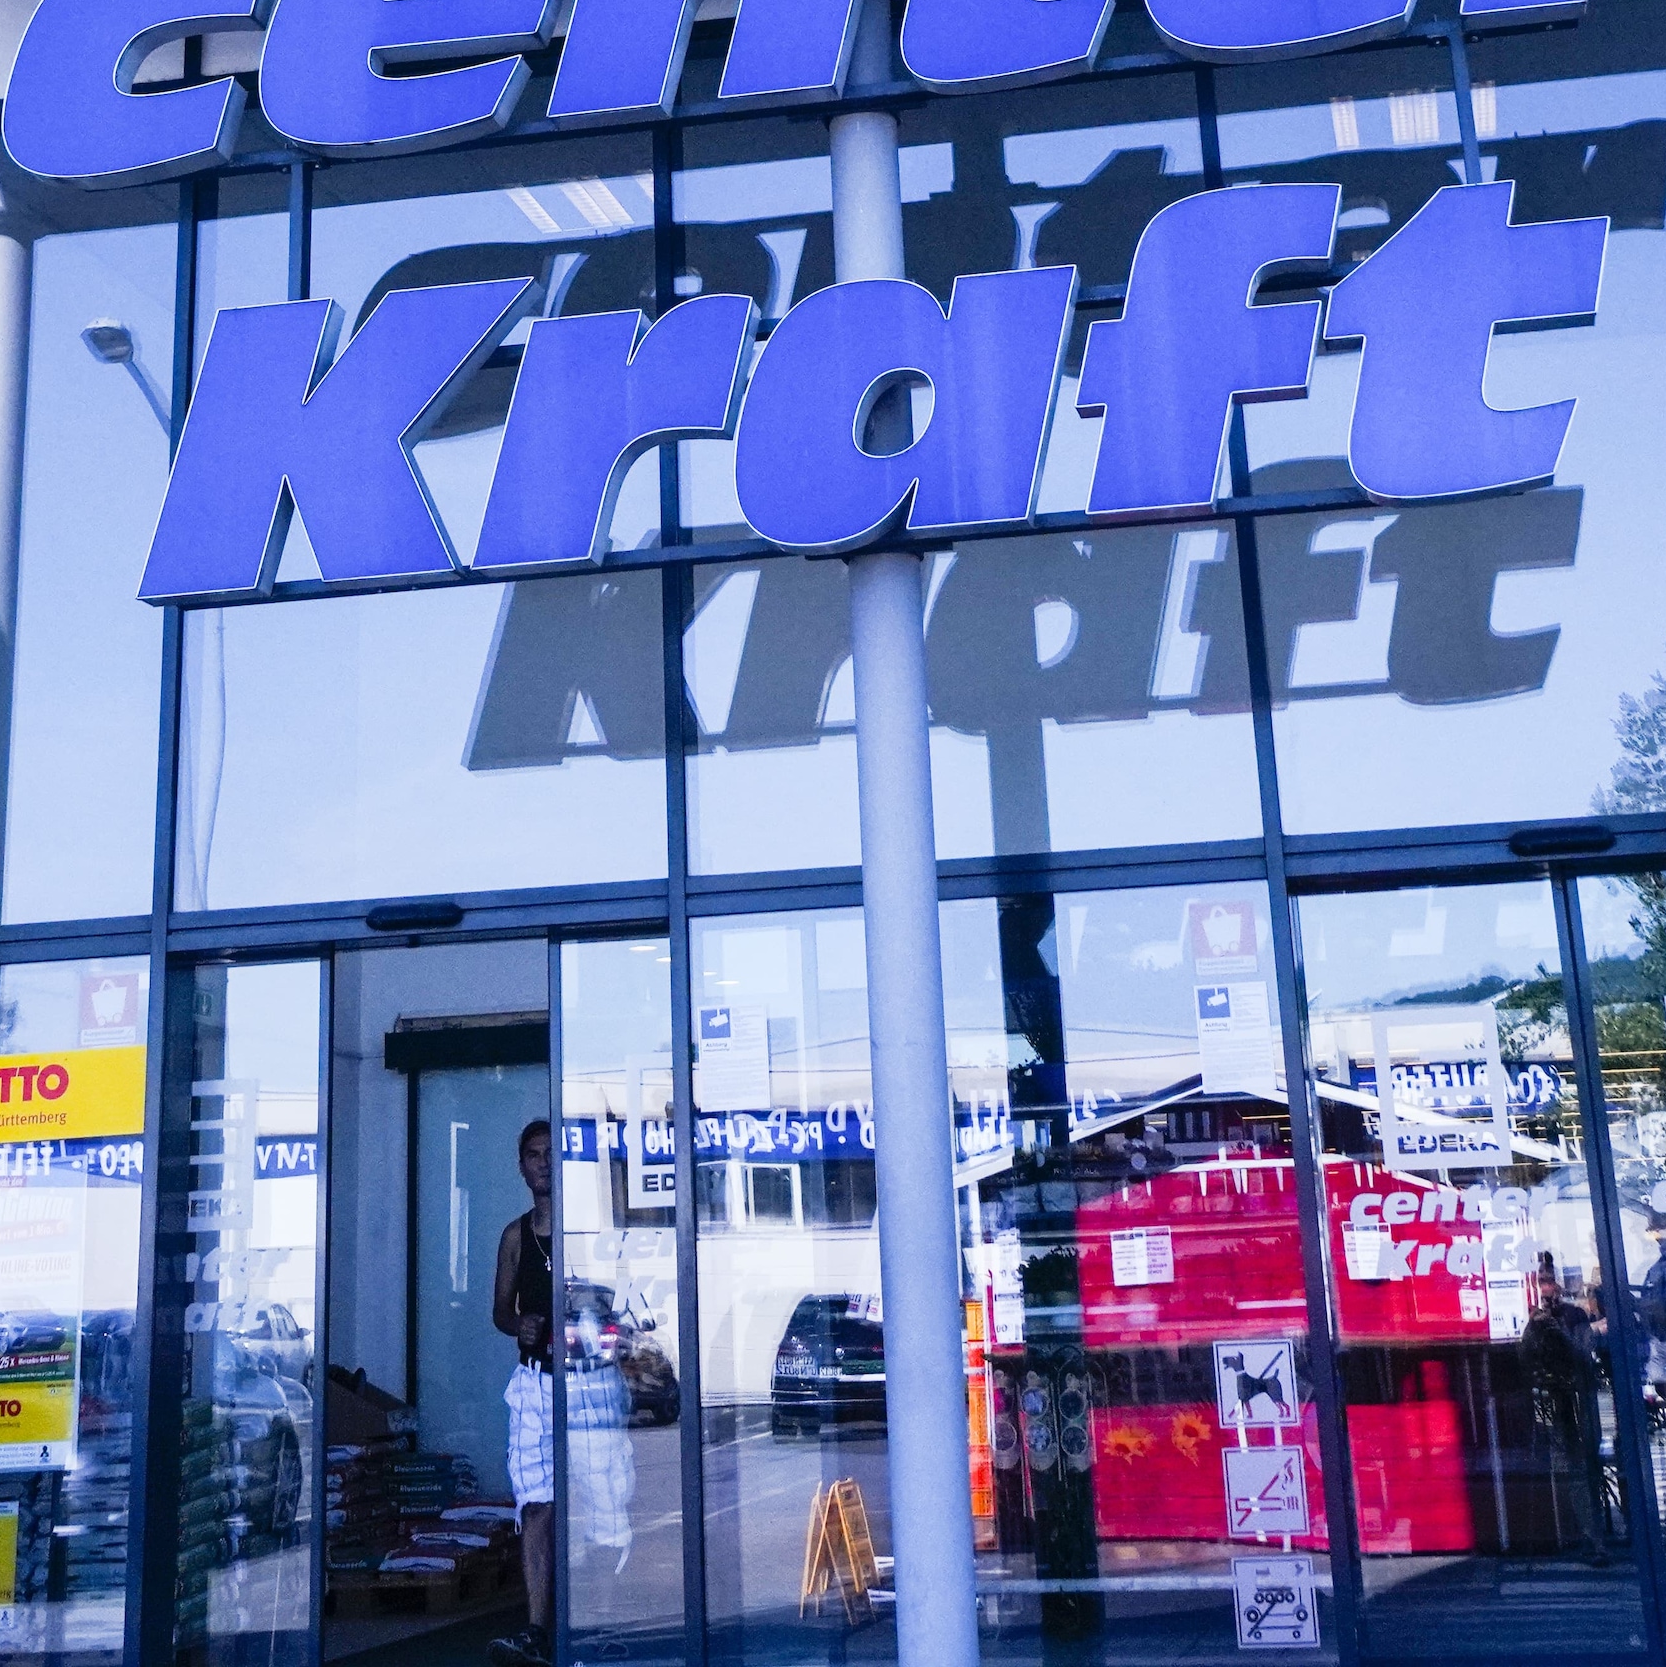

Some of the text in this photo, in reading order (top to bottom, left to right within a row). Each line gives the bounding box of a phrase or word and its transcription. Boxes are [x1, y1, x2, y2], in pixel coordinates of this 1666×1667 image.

[136, 179, 1611, 605] Kraft
[1398, 1130, 1501, 1156] EDEKA
[1349, 1183, 1559, 1226] center
